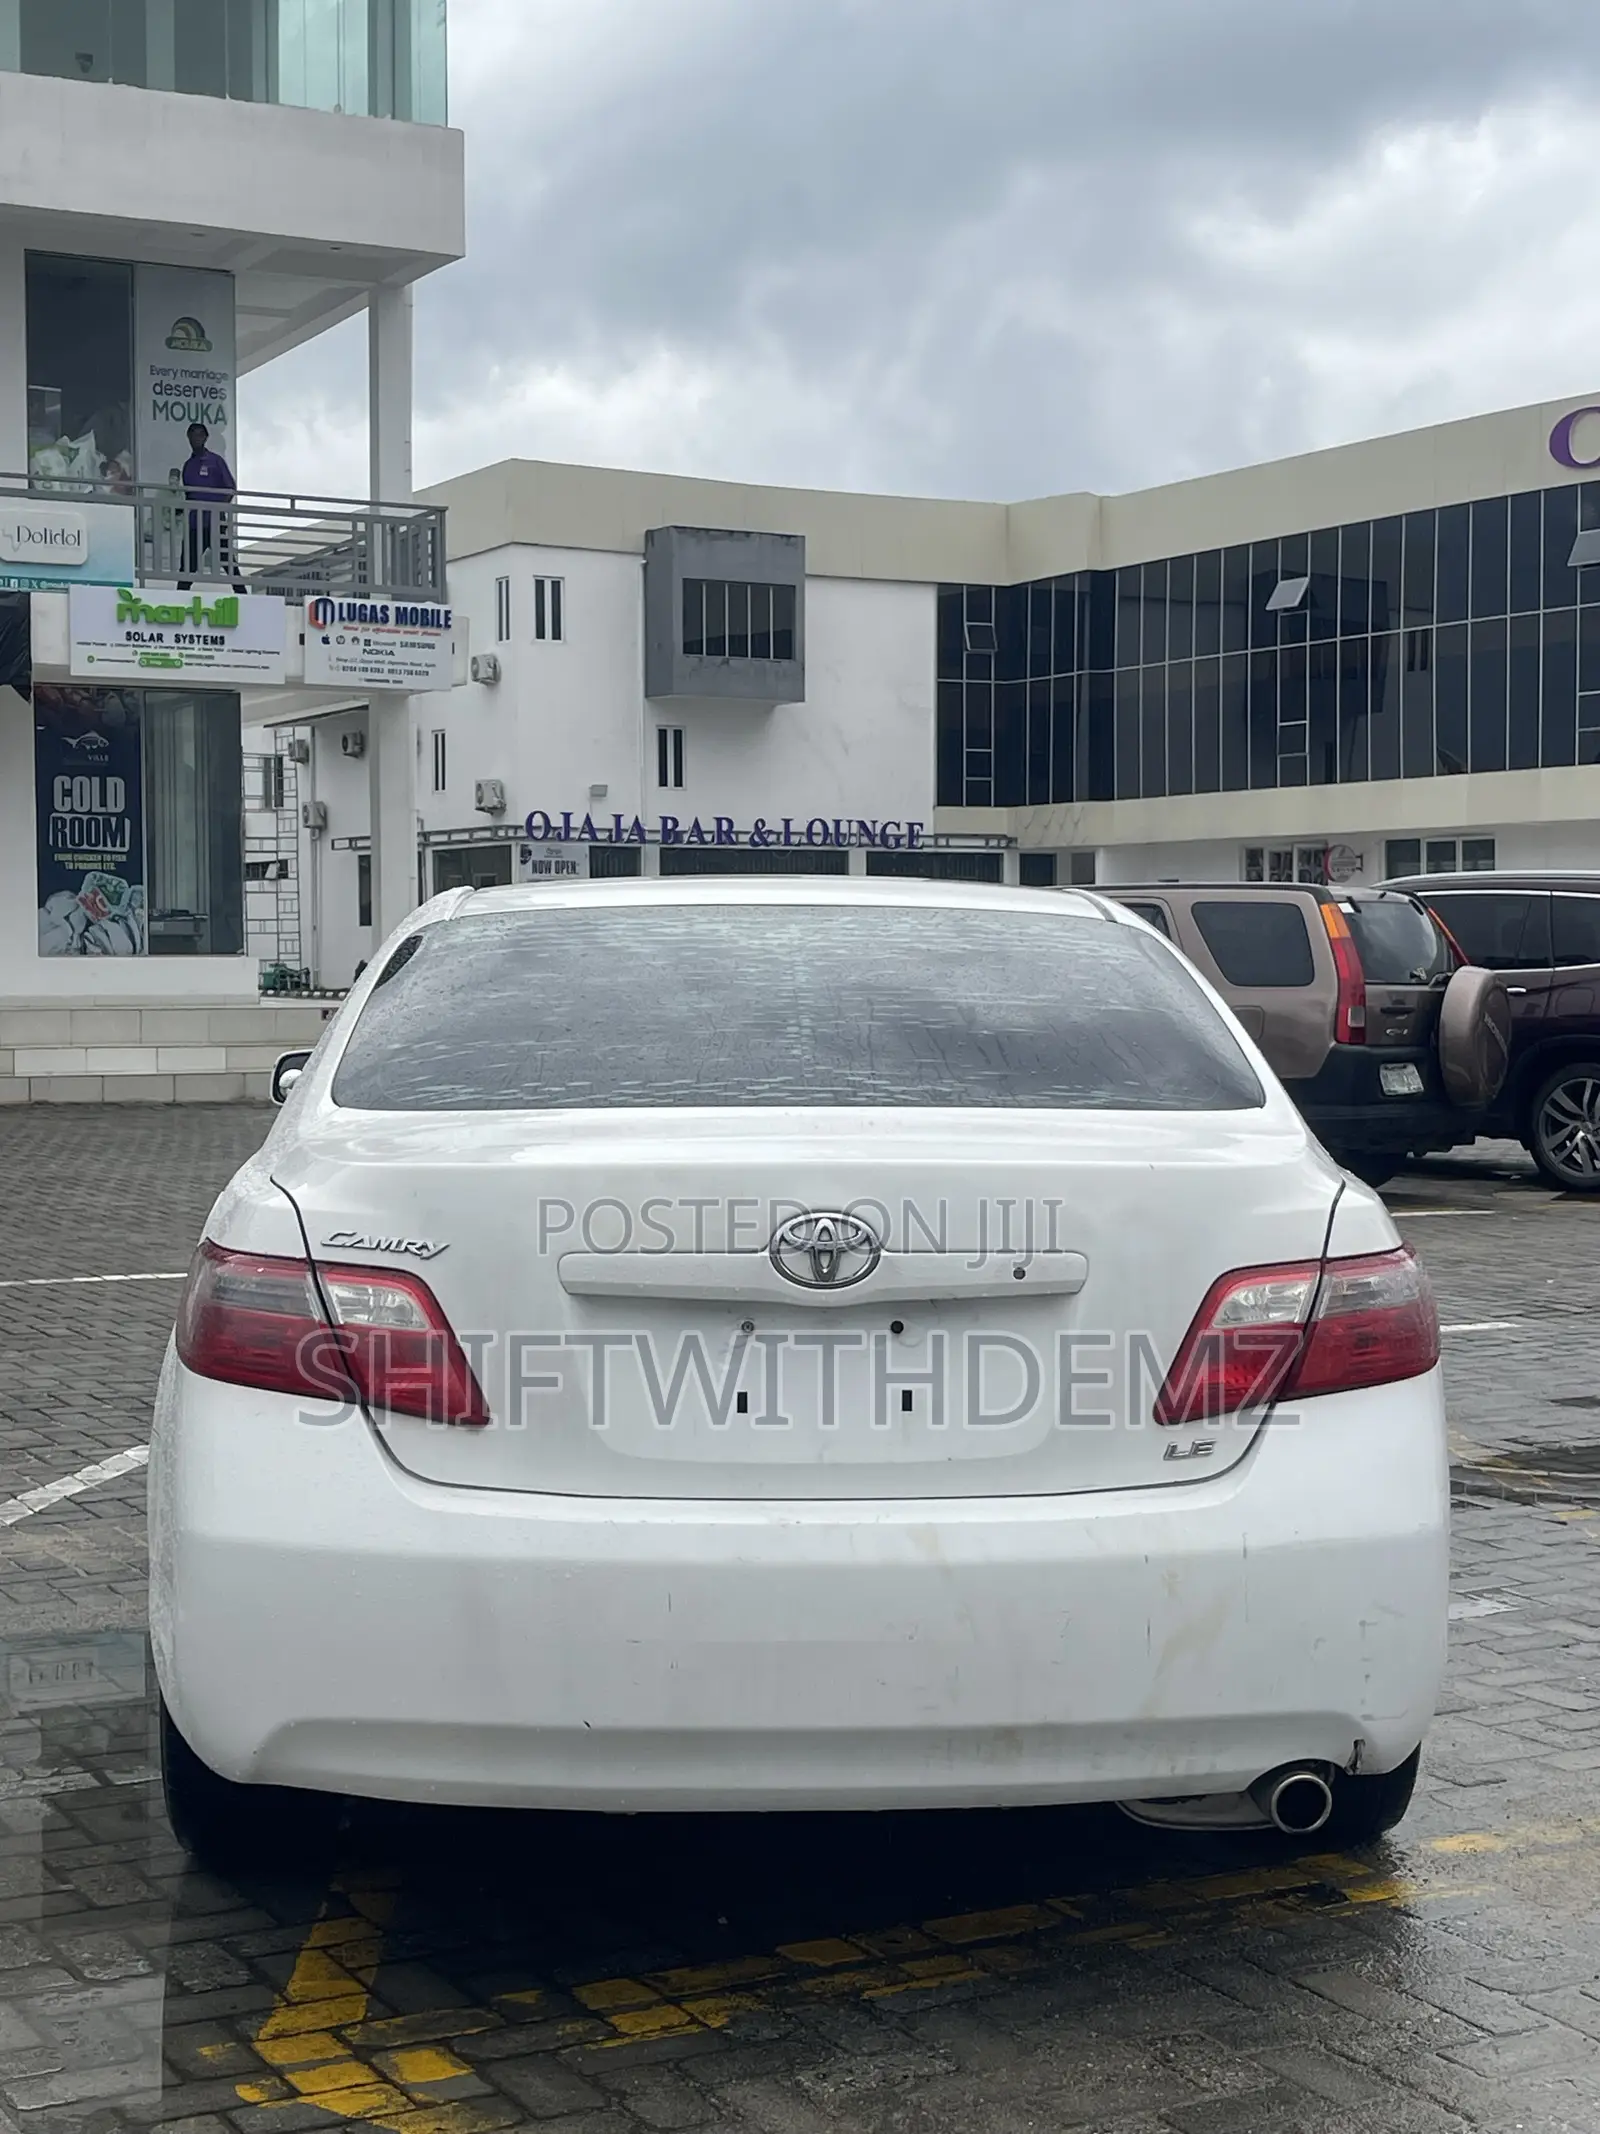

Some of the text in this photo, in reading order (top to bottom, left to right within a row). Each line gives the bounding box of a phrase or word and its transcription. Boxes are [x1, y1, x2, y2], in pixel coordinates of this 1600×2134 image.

[149, 365, 229, 383] Every marriage
[152, 380, 227, 400] deserves
[152, 400, 227, 425] MOUKA
[17, 525, 81, 547] Dolidol
[117, 596, 239, 628] marhill
[338, 602, 453, 630] LUGAS MOBILE
[125, 631, 225, 646] SOLAR SYSTEMS
[400, 640, 436, 650] SAMSUNG
[362, 648, 396, 657] NOKIA
[53, 775, 125, 813] COLD
[52, 816, 126, 848] ROOM
[525, 810, 926, 850] OJAJA BAR & LOUNGE
[531, 859, 552, 874] NOW
[320, 1231, 451, 1260] CAMRY
[1163, 1438, 1217, 1461] LE
